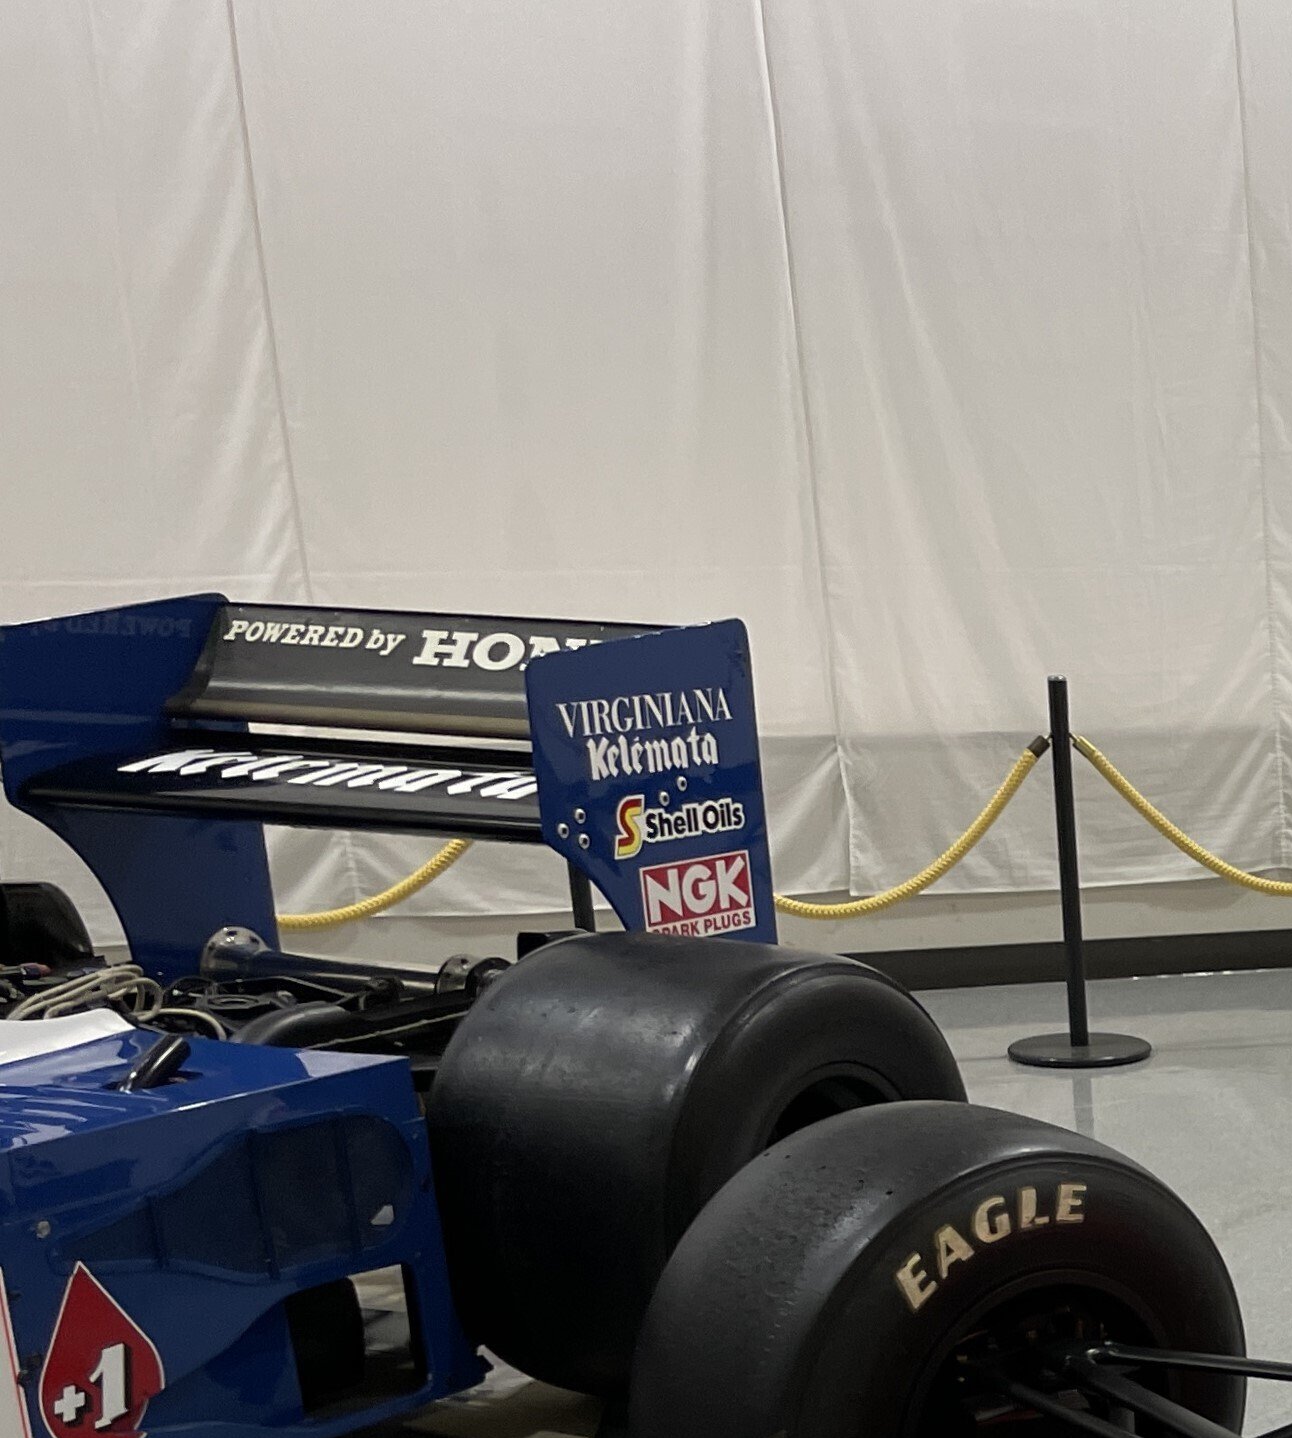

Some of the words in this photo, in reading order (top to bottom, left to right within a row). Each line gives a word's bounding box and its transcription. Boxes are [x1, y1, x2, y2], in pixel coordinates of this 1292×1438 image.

[223, 620, 366, 649] POWERED
[365, 627, 406, 656] by
[555, 687, 734, 739] VIRGINIANA
[645, 806, 700, 840] Shell
[702, 801, 742, 830] Oils
[645, 855, 749, 924] NGK
[703, 911, 751, 934] PLUGS
[893, 1183, 1088, 1312] EAGLE
